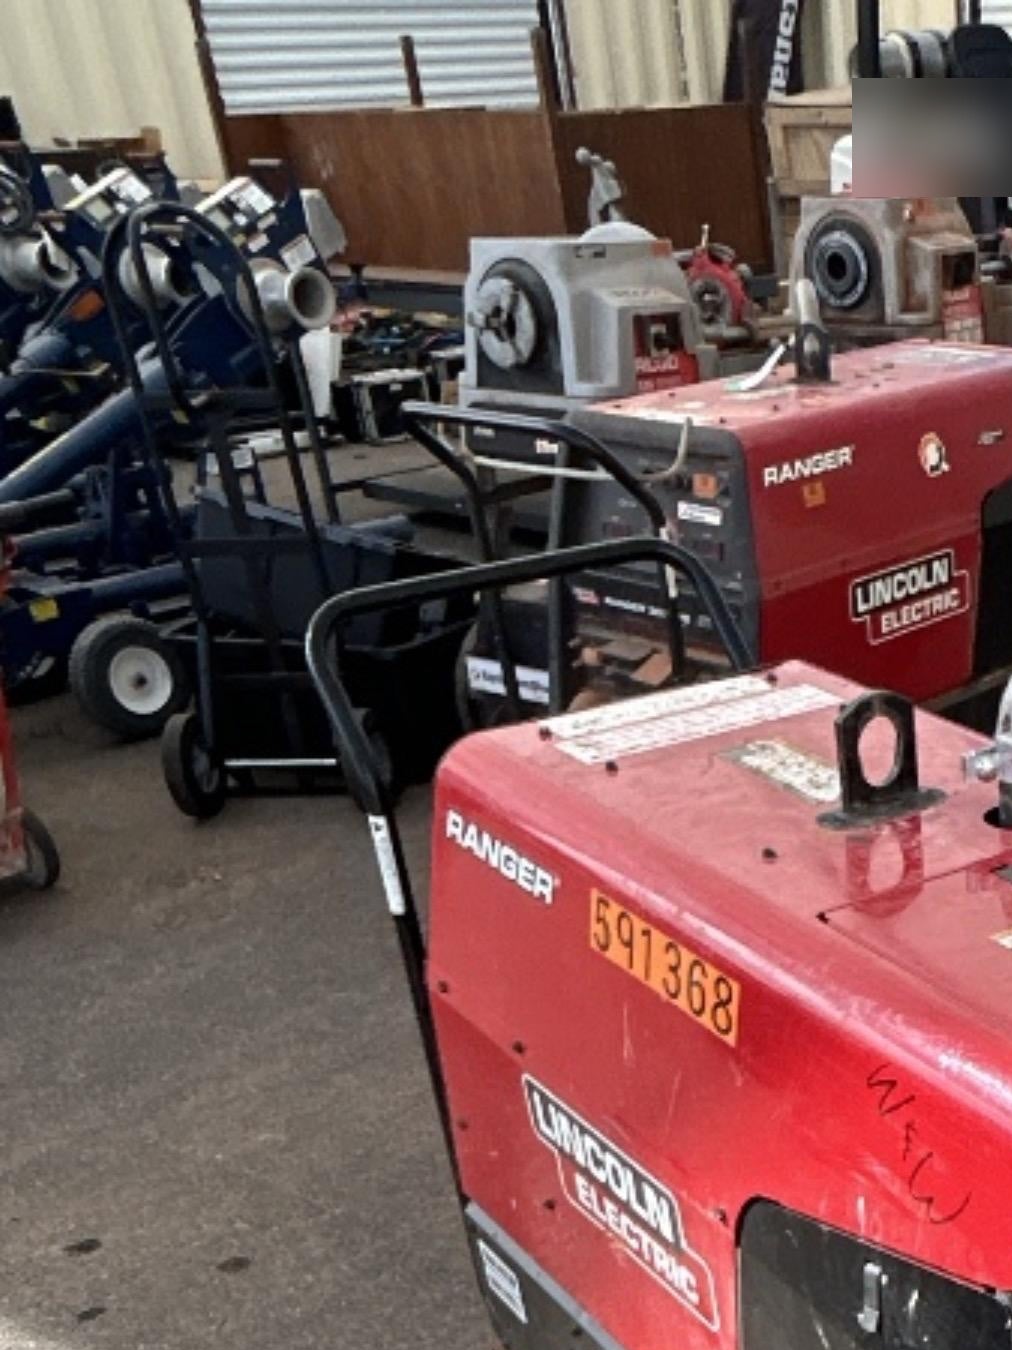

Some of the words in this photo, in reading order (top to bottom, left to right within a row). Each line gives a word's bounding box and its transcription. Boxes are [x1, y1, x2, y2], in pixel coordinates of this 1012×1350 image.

[763, 446, 853, 487] RANGER
[856, 558, 949, 614] LINCOLN
[881, 588, 960, 634] ELECTRIC
[446, 809, 552, 904] RANGER
[593, 896, 733, 1036] 591368
[533, 1091, 676, 1242] LINCOLN
[575, 1172, 700, 1306] ELECTRIC
